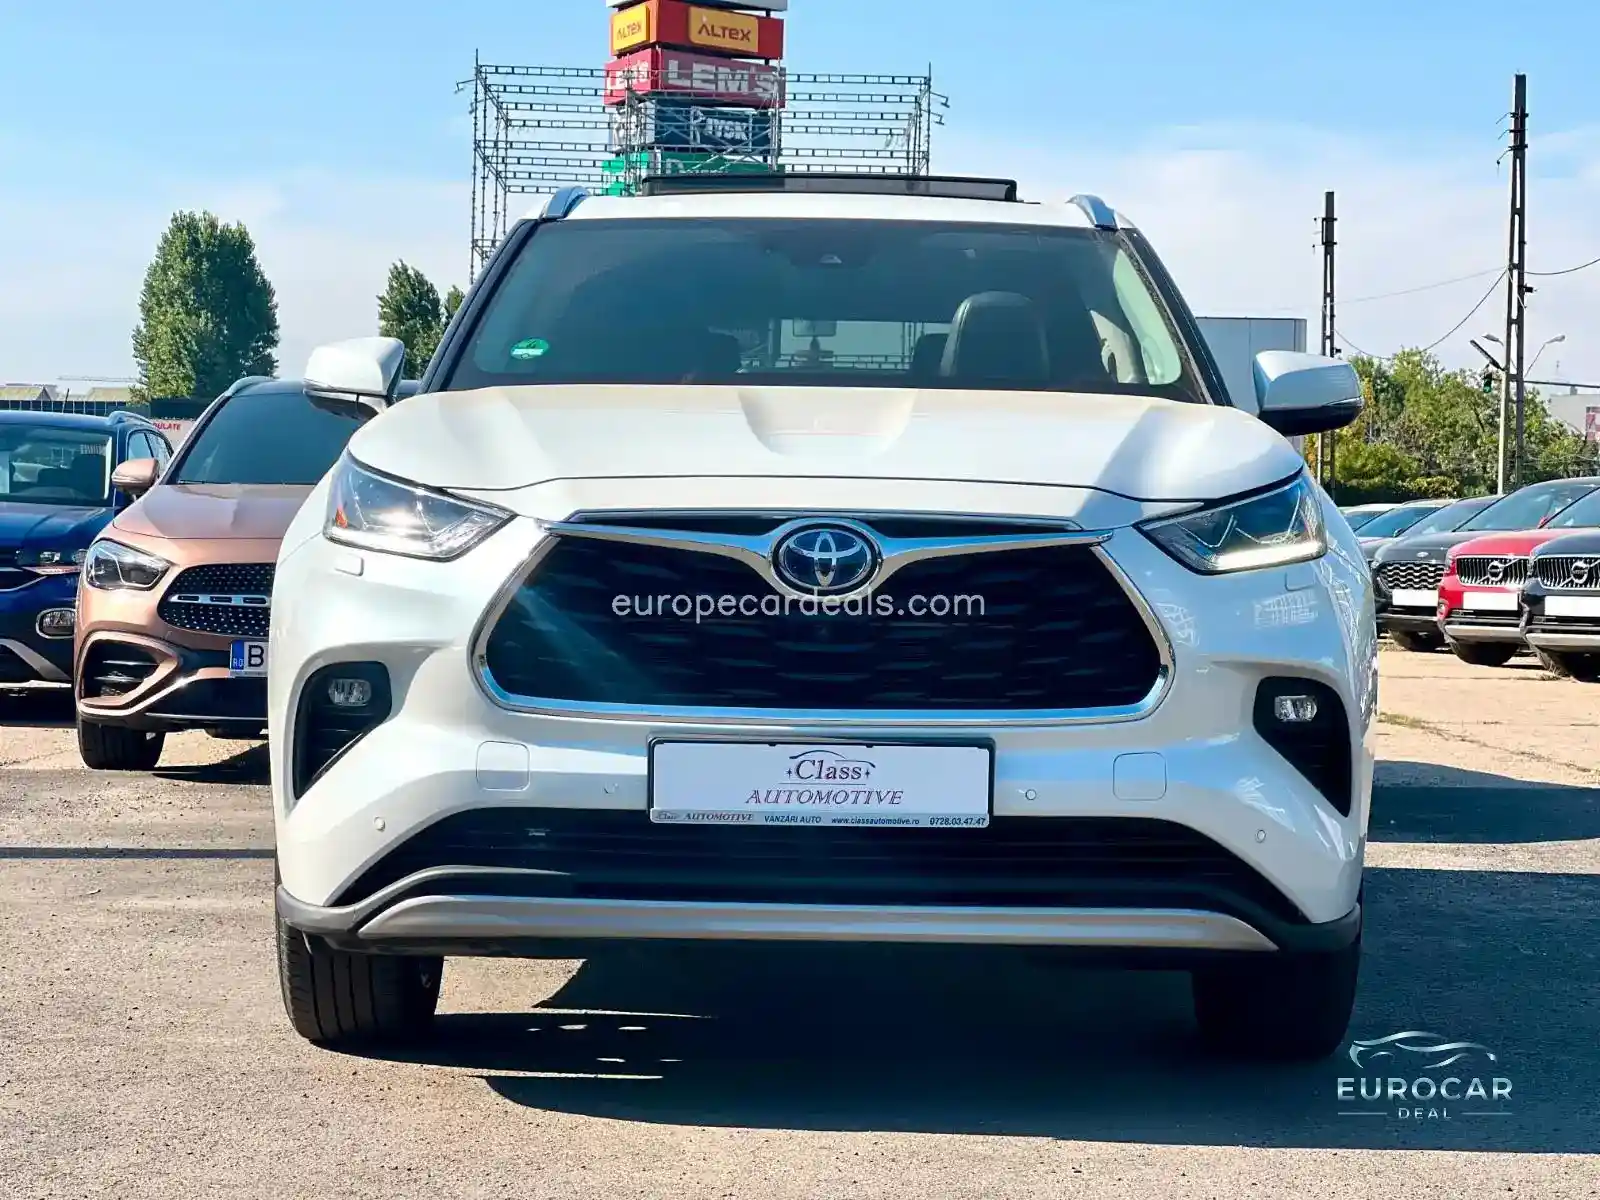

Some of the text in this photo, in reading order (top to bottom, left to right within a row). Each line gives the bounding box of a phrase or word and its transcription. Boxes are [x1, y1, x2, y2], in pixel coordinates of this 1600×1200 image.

[248, 644, 265, 667] B
[795, 759, 862, 780] Class
[745, 789, 904, 805] AUTOMOTIVE
[684, 813, 753, 821] AUTOMOTIVE
[800, 815, 822, 823] AUTO
[831, 817, 920, 825] www.classautomotive.ro
[929, 817, 986, 826] 0728.03.47.47
